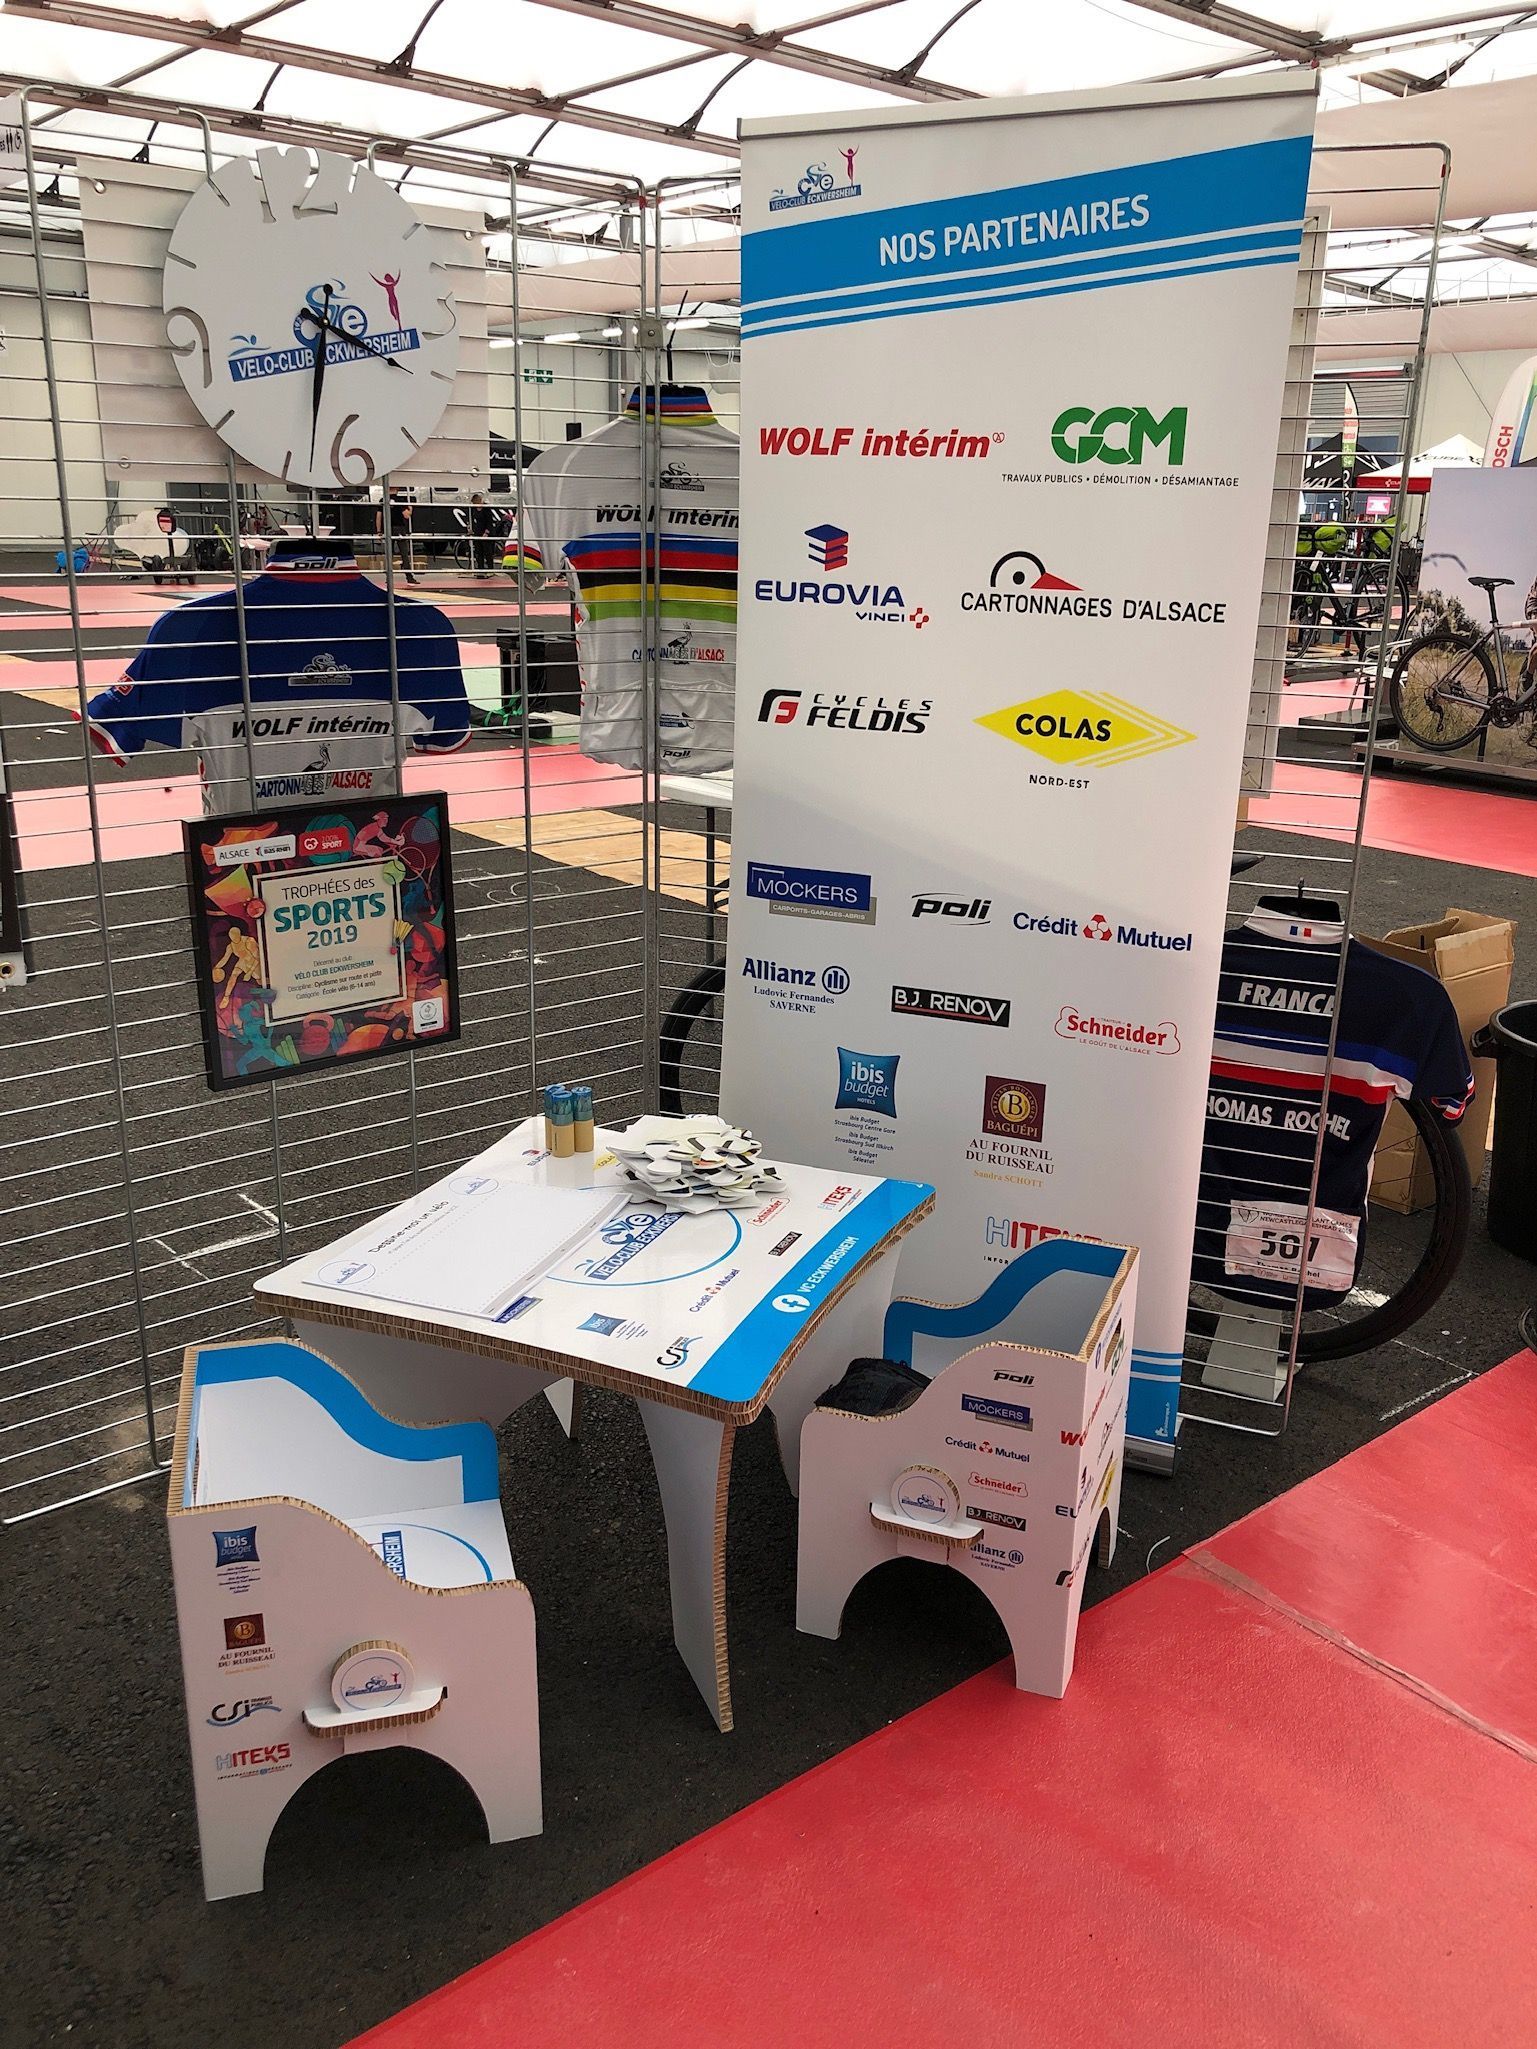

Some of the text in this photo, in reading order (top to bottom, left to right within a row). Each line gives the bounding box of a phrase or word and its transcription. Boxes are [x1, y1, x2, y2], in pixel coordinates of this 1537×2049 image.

[771, 187, 856, 210] VELO-CLUB ECKWERSHEIM
[880, 195, 1150, 266] NOS PARTENAIRES
[237, 332, 412, 379] VELO-CLUB CKWERSHEIM
[759, 427, 990, 458] WOLF intérim
[1050, 406, 1188, 466] GCM
[1492, 425, 1514, 467] OSCH
[330, 413, 375, 485] 6
[1001, 472, 1239, 488] TRAVAUX PUBLICS DÉMOLITION DÉSAMIANTAGE
[754, 579, 906, 608] EUROVIA
[855, 611, 905, 623] VINCI
[960, 592, 1228, 624] CARTONNAGES D'ALSACE
[813, 692, 933, 712] CYCLES
[232, 715, 390, 739] WOLF intérim
[806, 706, 931, 735] FELDIS
[1015, 712, 1112, 743] COLAS
[1029, 774, 1090, 790] NORD-EST
[219, 848, 250, 860] ALSACE
[321, 839, 344, 850] SPORT
[281, 877, 375, 900] TROPHÉES des
[757, 877, 858, 904] MOCKERS
[273, 892, 387, 933] SPORTS
[911, 897, 992, 922] poli
[307, 925, 358, 949] 2019
[1013, 911, 1193, 952] Crédit Mutuel
[312, 967, 329, 978] CLUB
[329, 960, 375, 974] ECKWERSHEIM
[742, 957, 816, 987] Allianz
[754, 985, 835, 1005] Ludovic Fernandes
[769, 1000, 816, 1014] SAVERNE
[930, 993, 1008, 1023] RENOV
[1067, 1014, 1167, 1046] Schneider
[850, 1061, 885, 1084] ibis
[844, 1078, 889, 1099] budget
[1007, 1093, 1023, 1117] B
[834, 1119, 864, 1131] Strasbourg
[986, 1119, 1040, 1138] BAGUÉPI
[1206, 1095, 1351, 1142] HOMAS ROCHEL
[969, 1138, 1053, 1161] AU FOURNIL
[965, 1150, 1055, 1175] DU RUISSEAU
[1004, 1174, 1045, 1188] SCHOTT
[593, 1213, 682, 1278] VELO-CLUB ECKWERS
[796, 1236, 860, 1294] VC ECKWERSHEIM
[689, 1268, 740, 1313] Crédit Mutuel
[994, 1371, 1035, 1385] poli
[968, 1401, 1024, 1421] MOCKERS
[945, 1436, 1030, 1463] Crédit Mutuel
[974, 1475, 1022, 1494] Schneider
[985, 1511, 1025, 1529] RENOV
[223, 1535, 248, 1549] ibis
[384, 1535, 405, 1577] ERSHEIM
[216, 1742, 291, 1772] HITEKS
